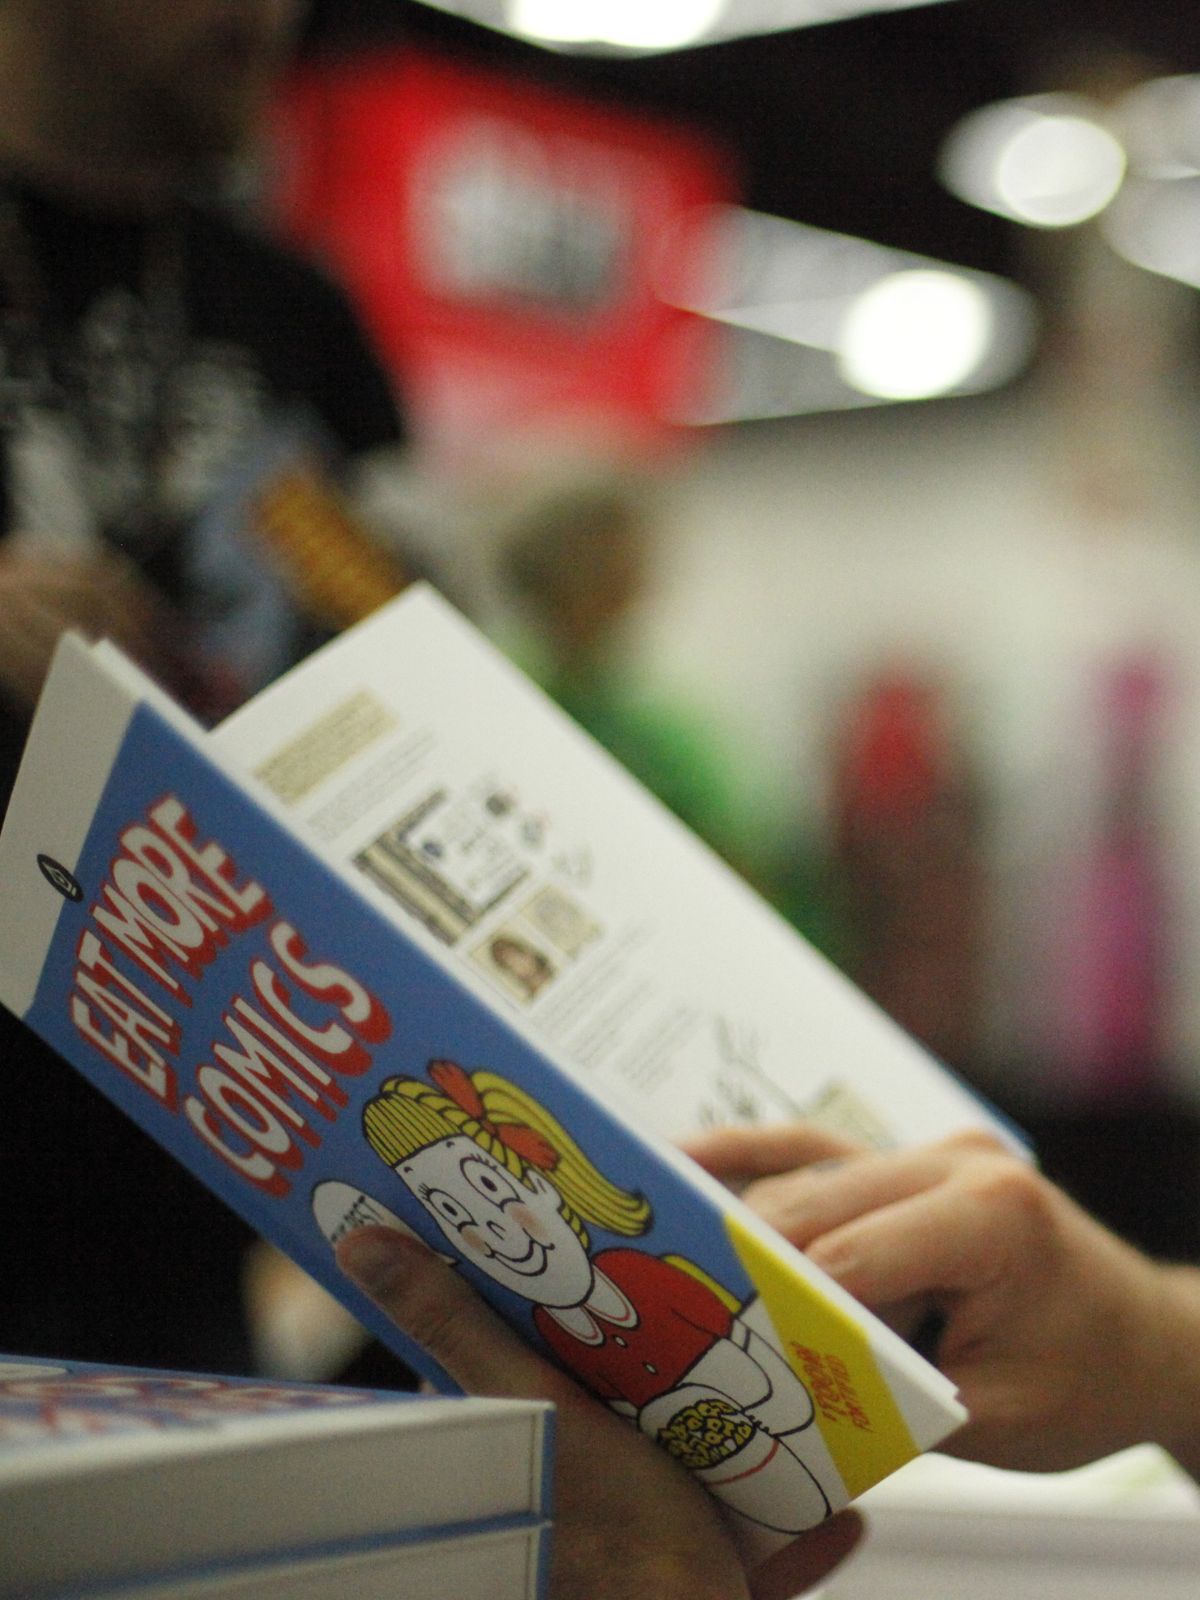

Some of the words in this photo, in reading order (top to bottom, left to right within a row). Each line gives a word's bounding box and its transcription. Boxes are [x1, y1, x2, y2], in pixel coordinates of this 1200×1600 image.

[90, 794, 273, 1007] MORE
[70, 928, 178, 1111] EAT
[184, 920, 390, 1200] COMICS
